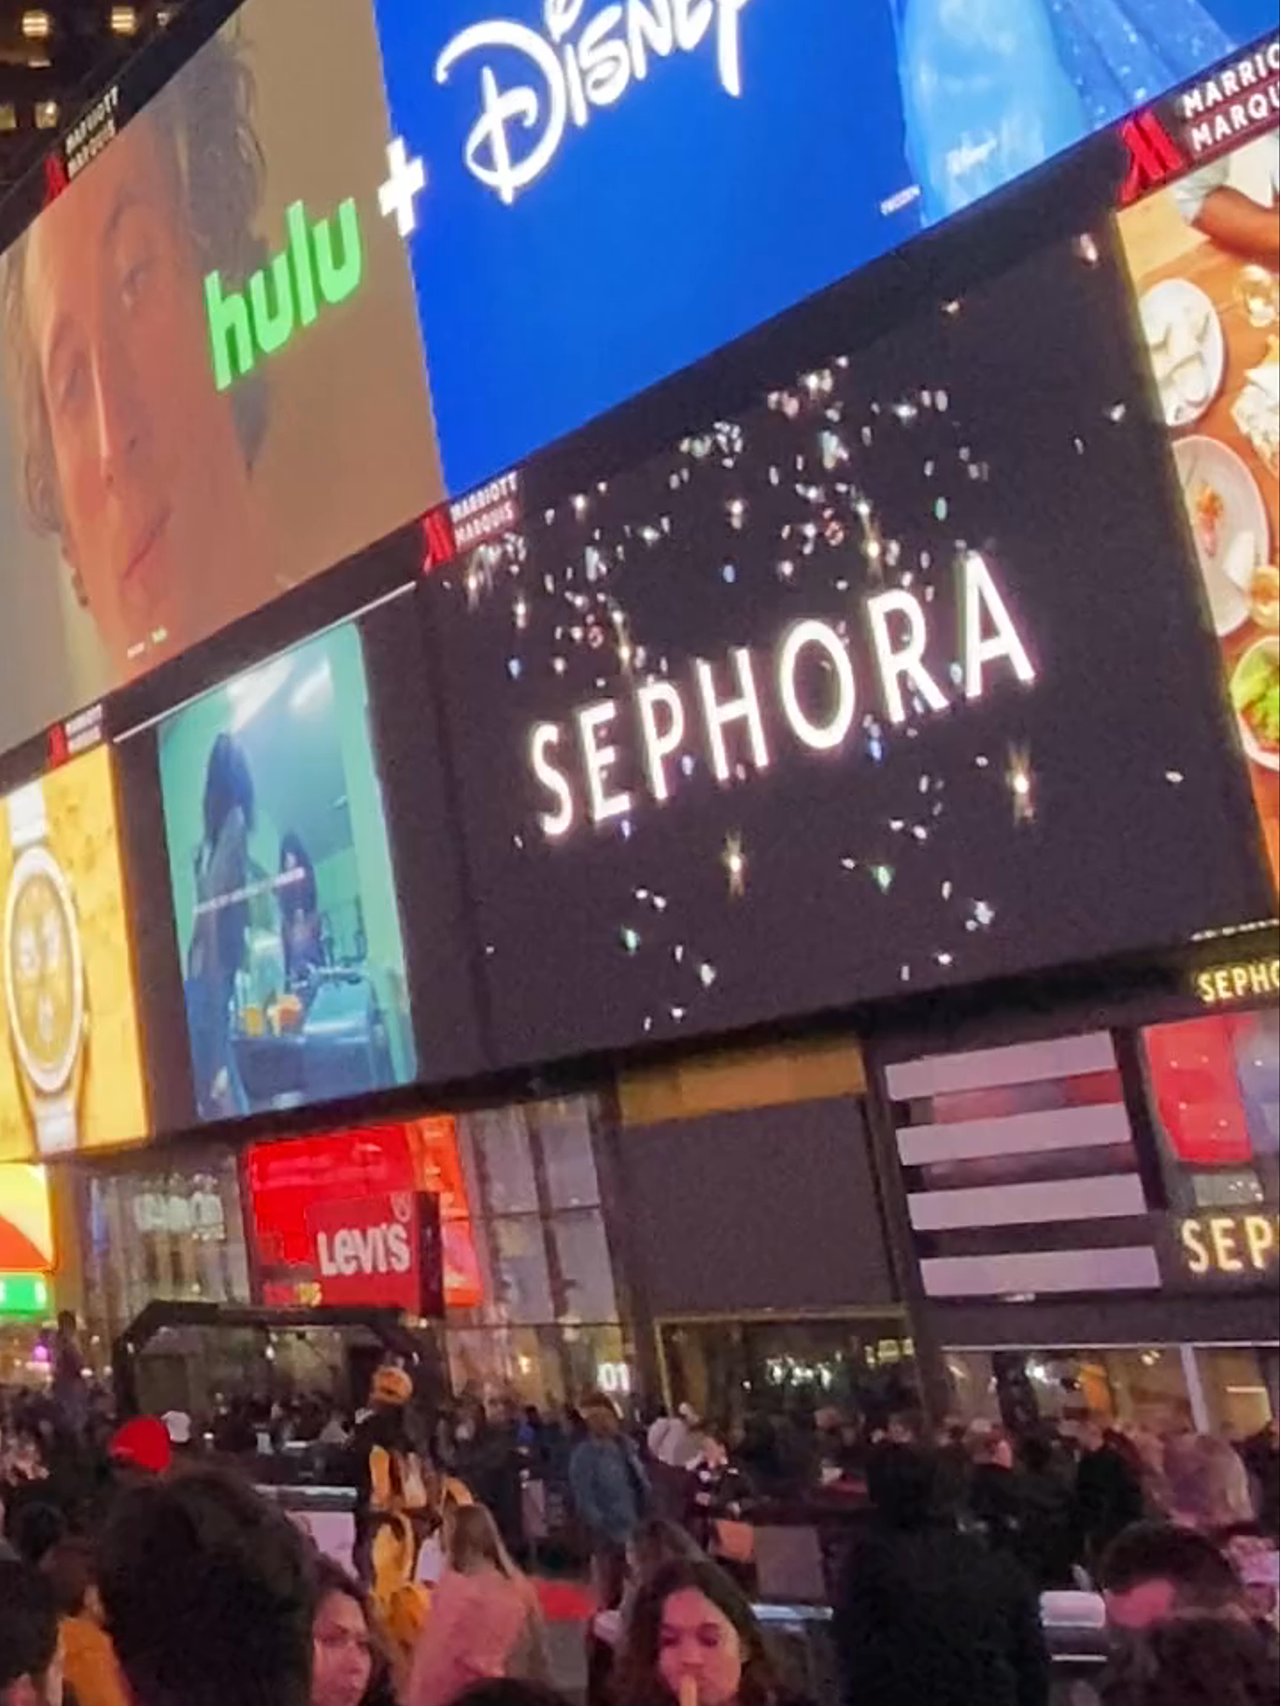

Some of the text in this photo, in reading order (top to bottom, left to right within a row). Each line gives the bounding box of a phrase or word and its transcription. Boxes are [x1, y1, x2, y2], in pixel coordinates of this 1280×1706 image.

[202, 195, 363, 392] hulu
[450, 471, 518, 524] MARRIOTT
[454, 500, 514, 553] MARQUIS
[530, 547, 1037, 838] SEPHORA
